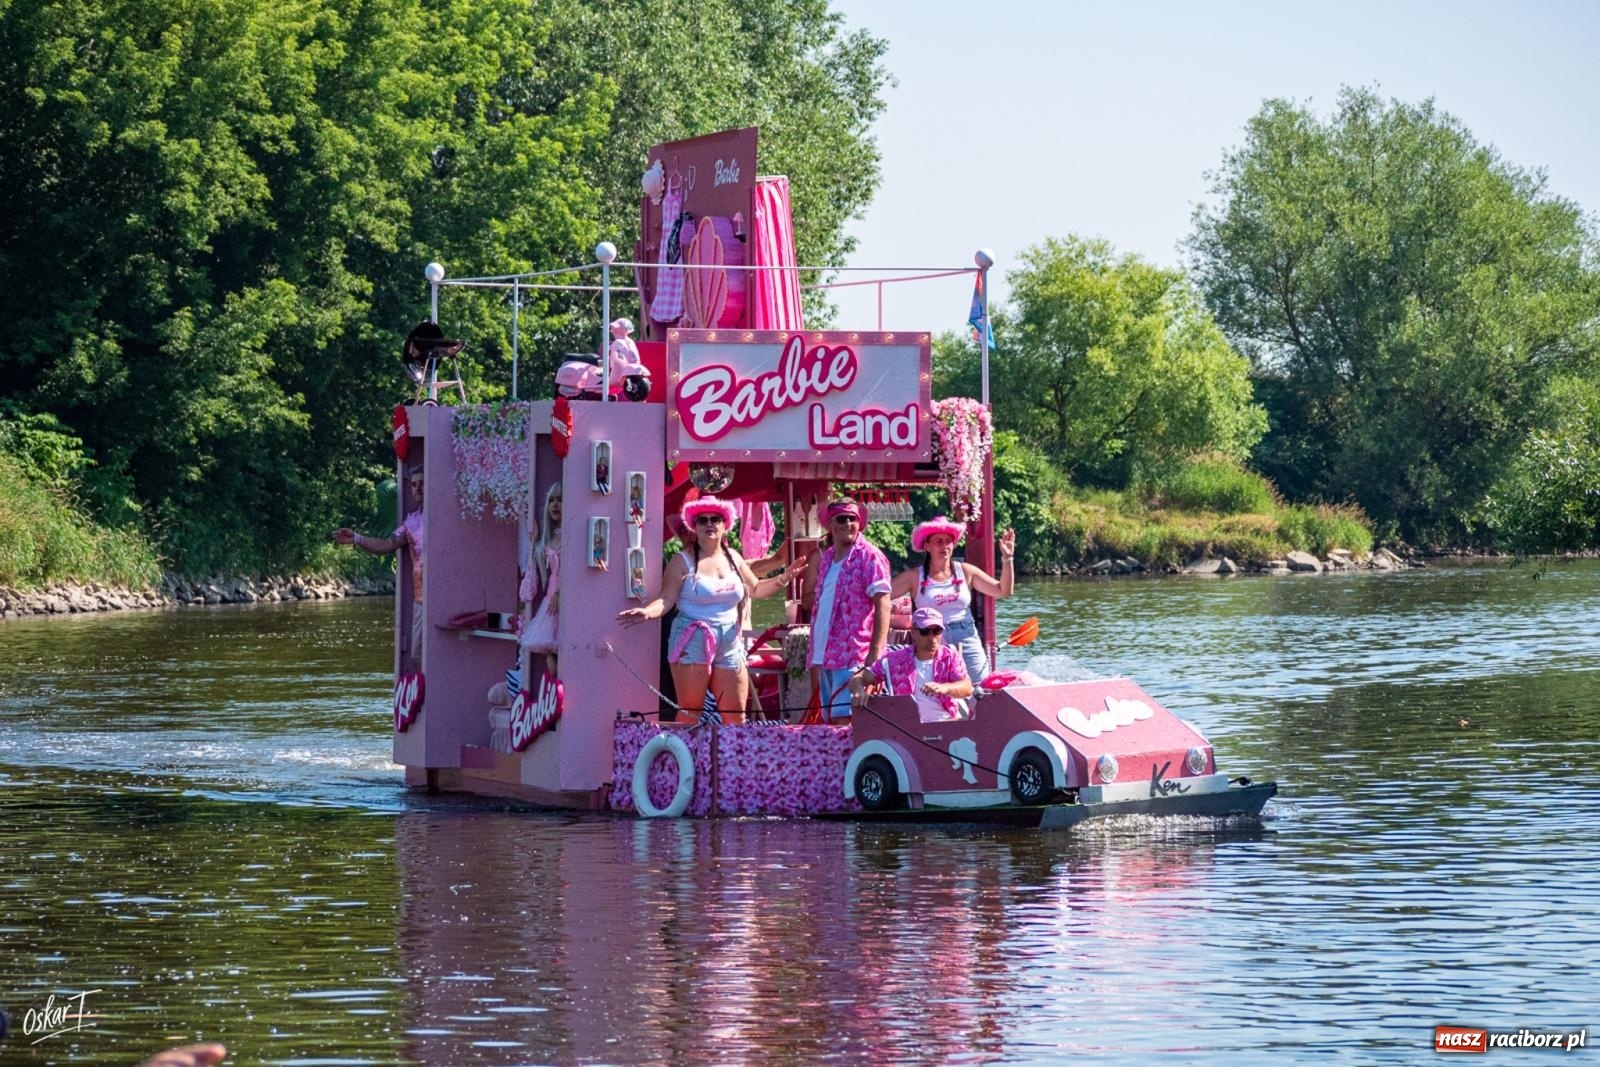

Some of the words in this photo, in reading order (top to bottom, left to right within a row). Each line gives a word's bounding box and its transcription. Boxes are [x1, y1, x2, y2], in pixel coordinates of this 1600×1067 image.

[680, 337, 854, 438] Barbie
[812, 404, 917, 447] Land
[511, 674, 557, 748] Barbie
[1150, 761, 1191, 797] Ken
